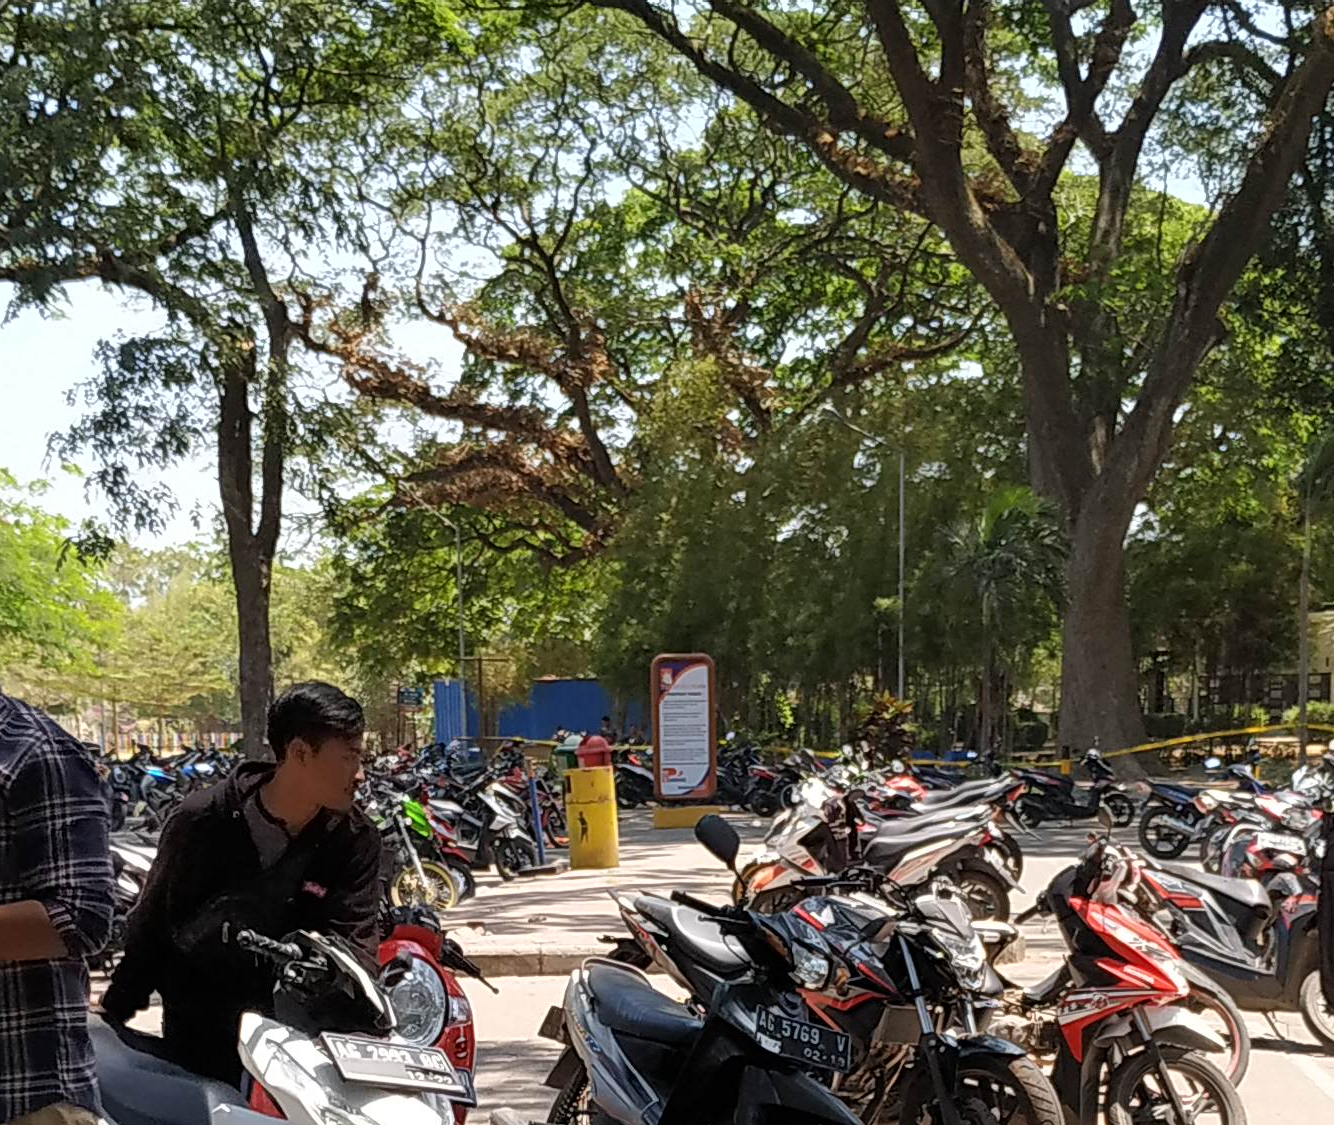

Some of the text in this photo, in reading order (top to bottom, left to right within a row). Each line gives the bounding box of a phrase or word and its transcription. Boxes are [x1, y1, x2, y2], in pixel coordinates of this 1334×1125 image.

[759, 1010, 846, 1053] AG 5769 V
